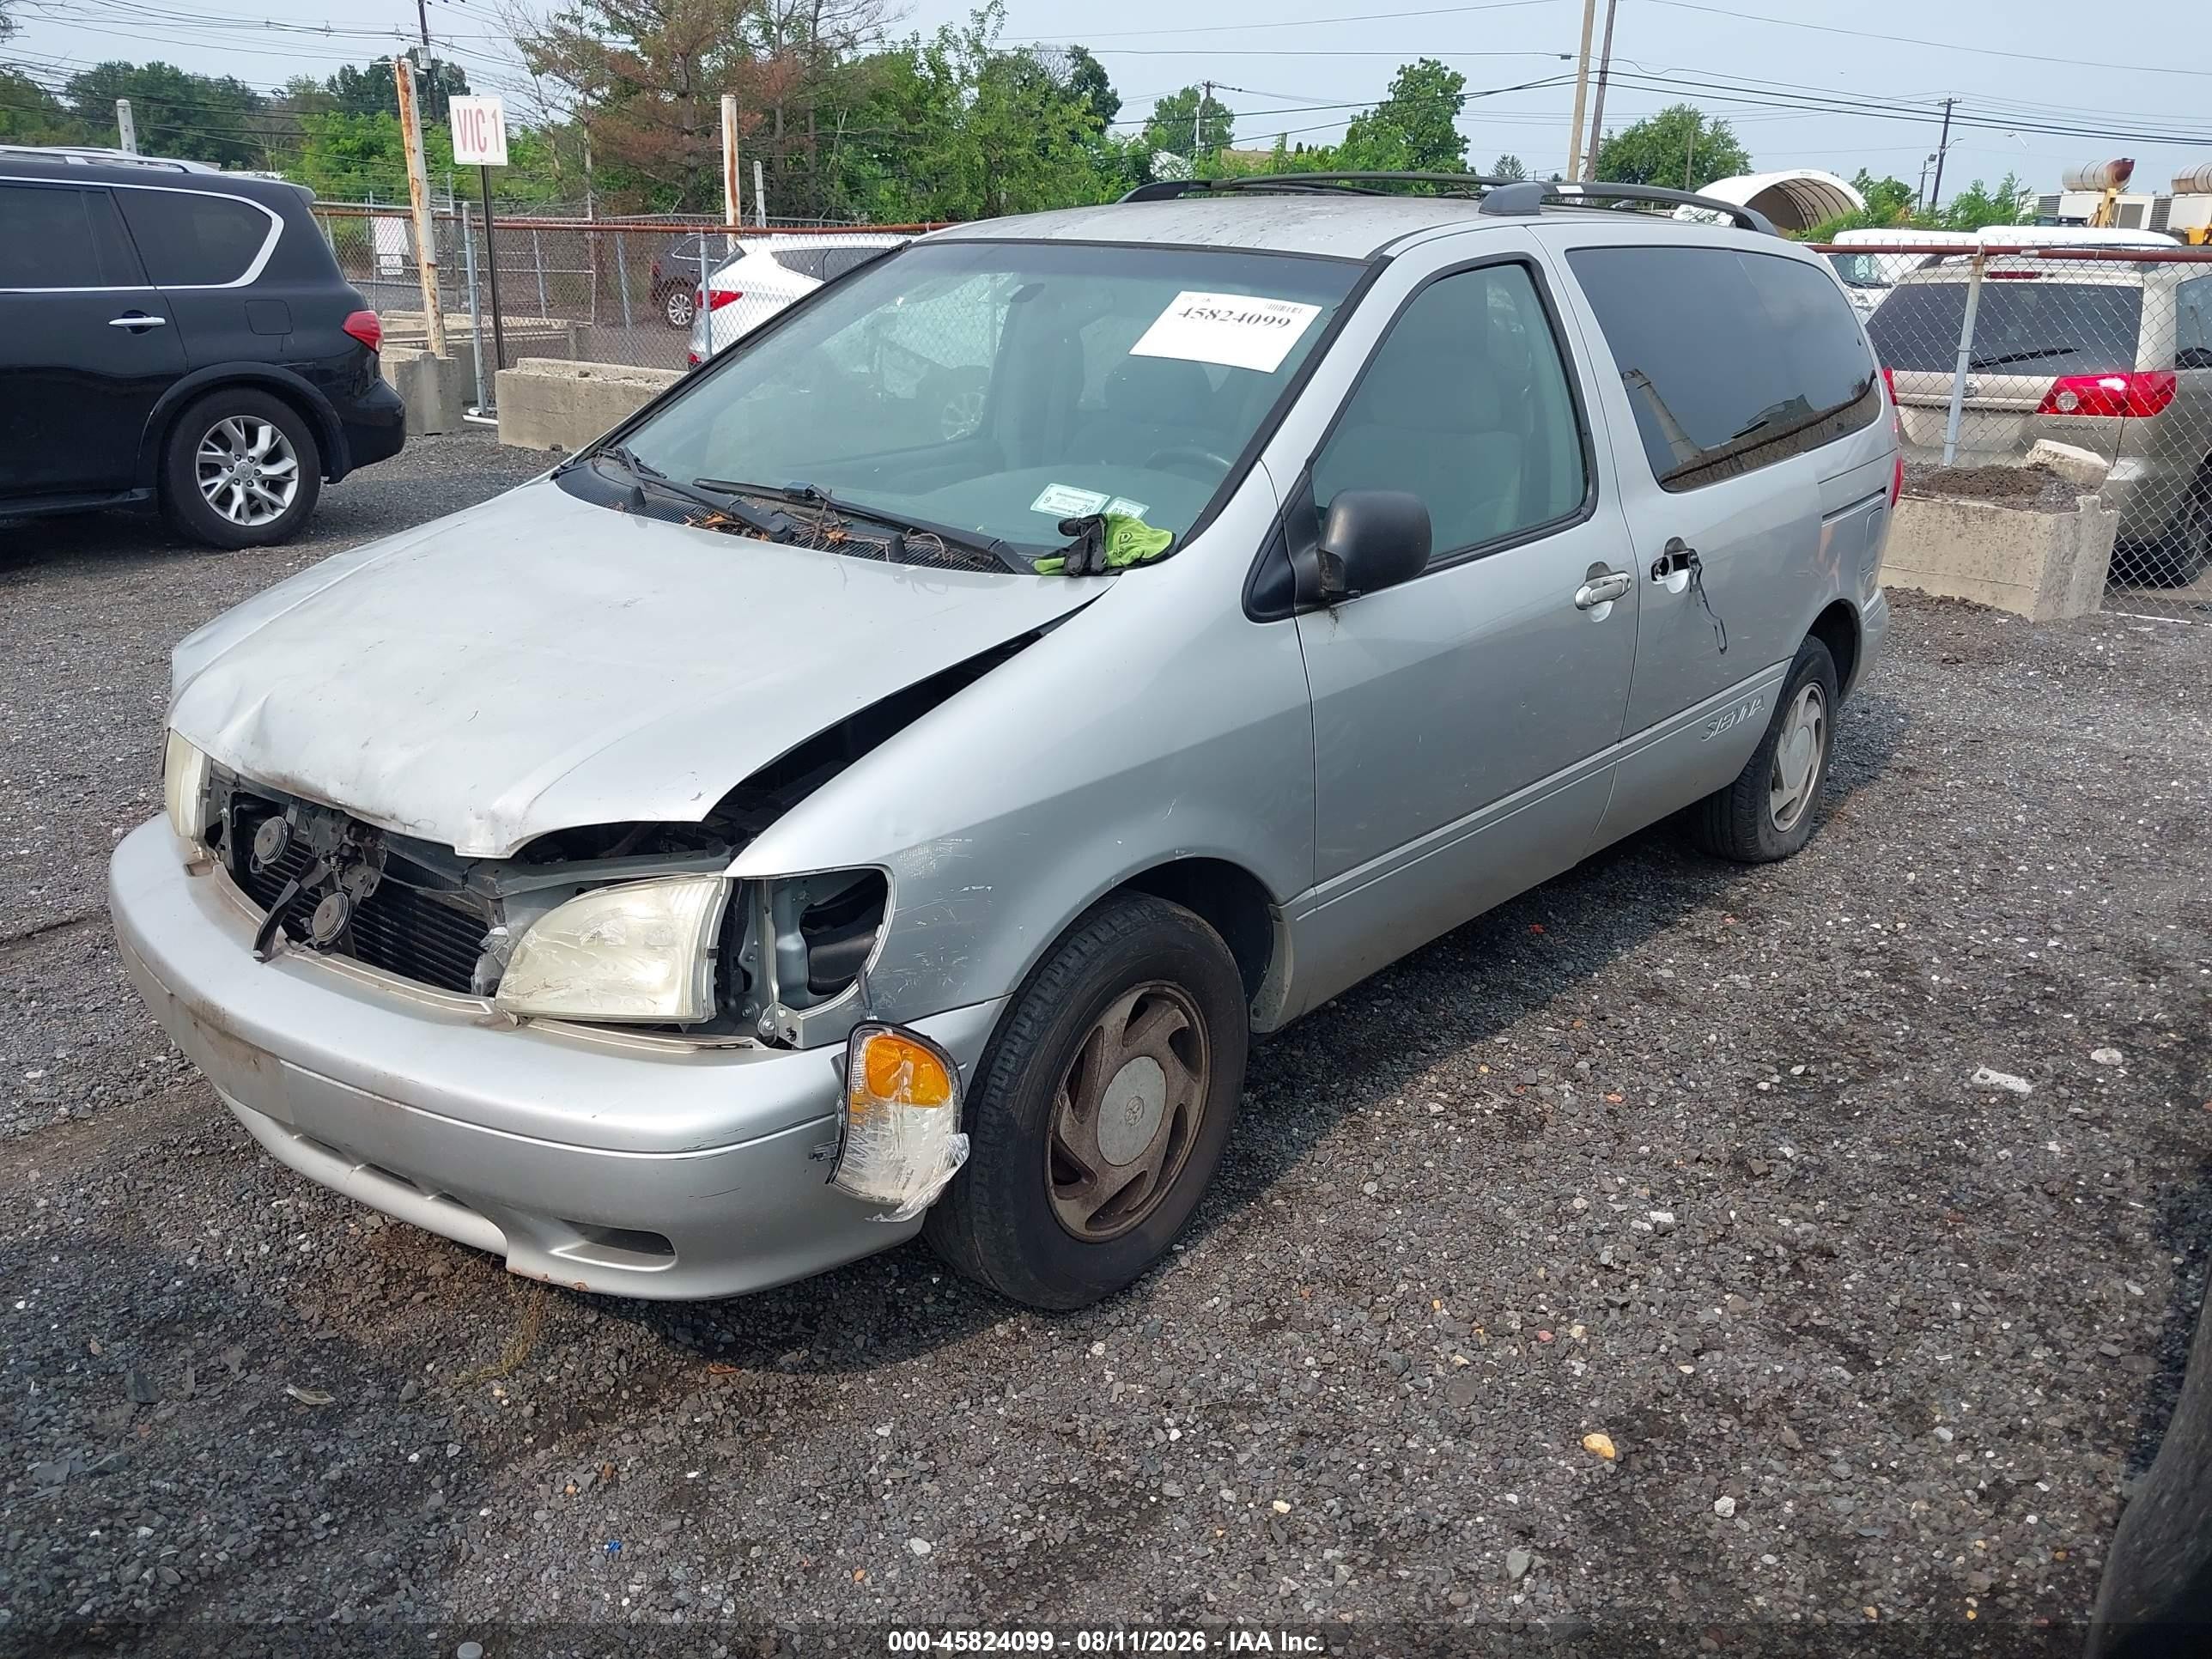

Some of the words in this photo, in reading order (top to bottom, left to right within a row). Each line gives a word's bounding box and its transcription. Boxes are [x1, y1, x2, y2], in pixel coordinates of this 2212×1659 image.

[456, 108, 487, 153] VIC
[491, 108, 500, 153] 1
[1177, 306, 1291, 329] 45824099
[1043, 496, 1052, 505] 9
[1079, 504, 1093, 514] 26
[1701, 695, 1765, 742] SIENNA
